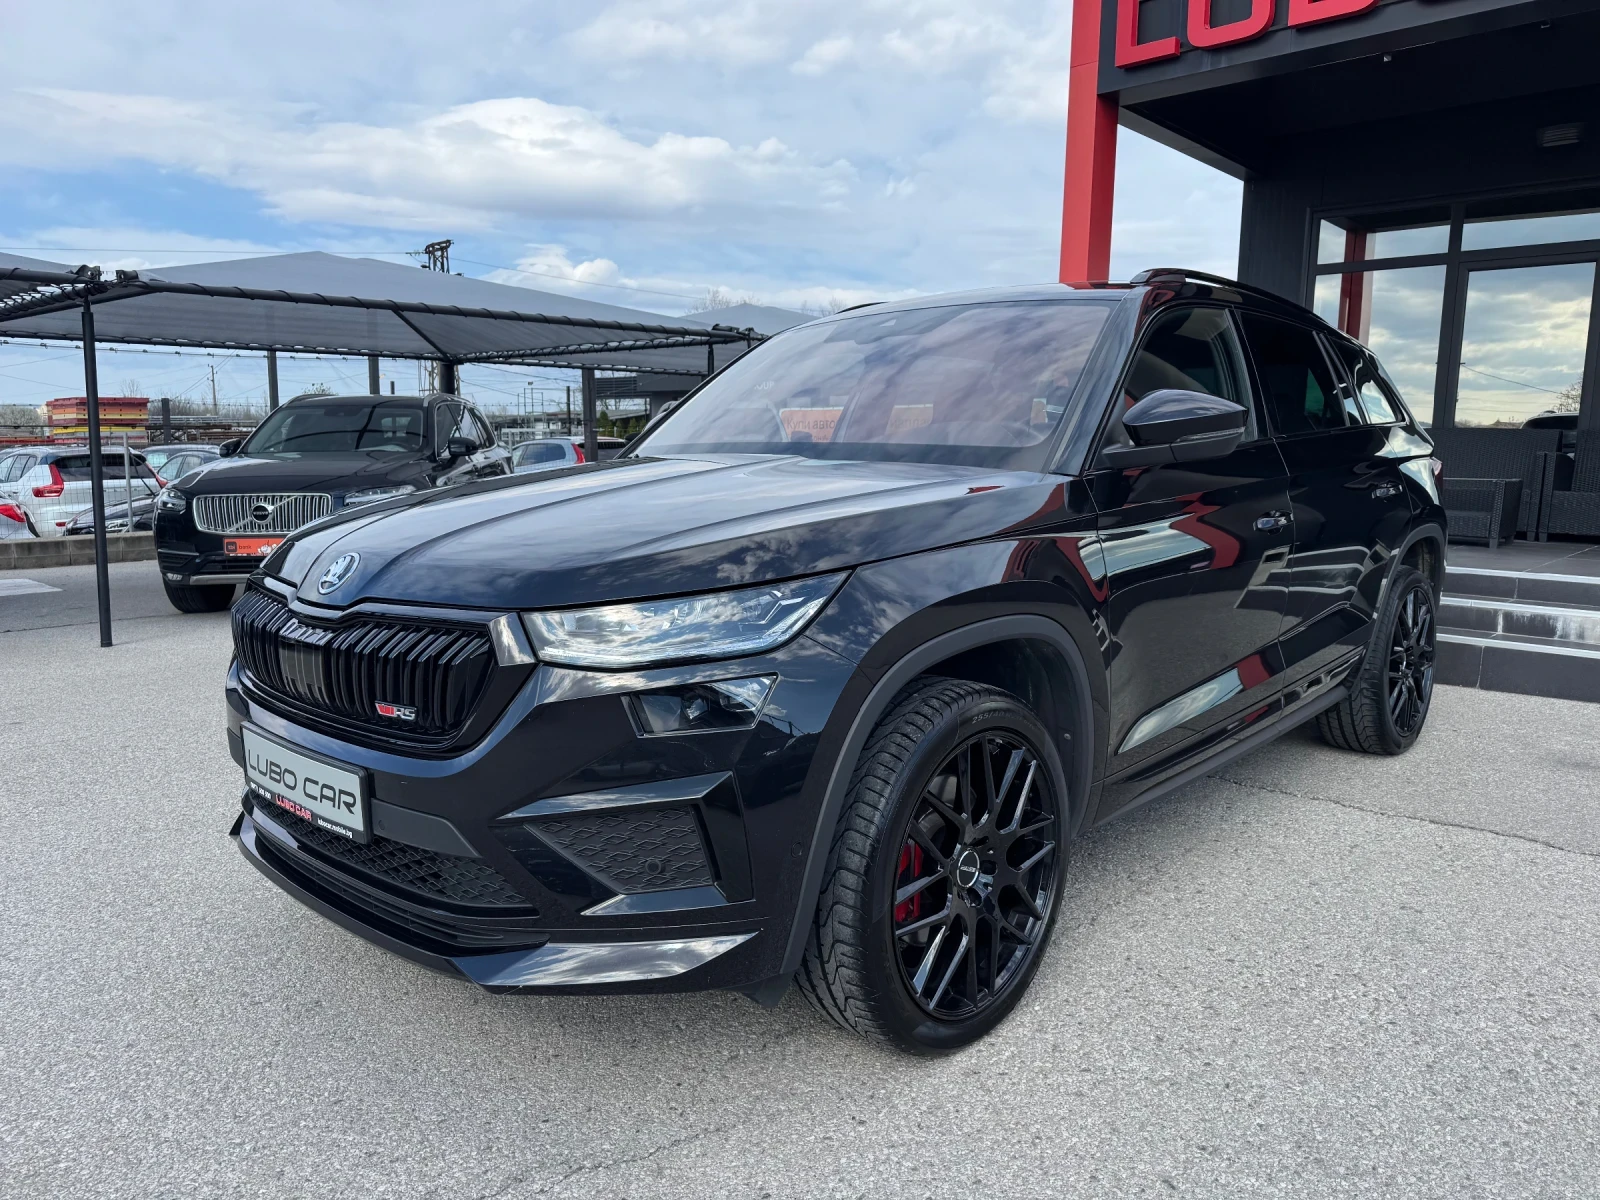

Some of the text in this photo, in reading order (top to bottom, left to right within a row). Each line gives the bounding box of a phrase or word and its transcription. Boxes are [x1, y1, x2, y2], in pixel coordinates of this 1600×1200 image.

[248, 748, 298, 791] LUBO
[303, 776, 357, 815] CAR
[275, 795, 312, 821] LUBO CAR
